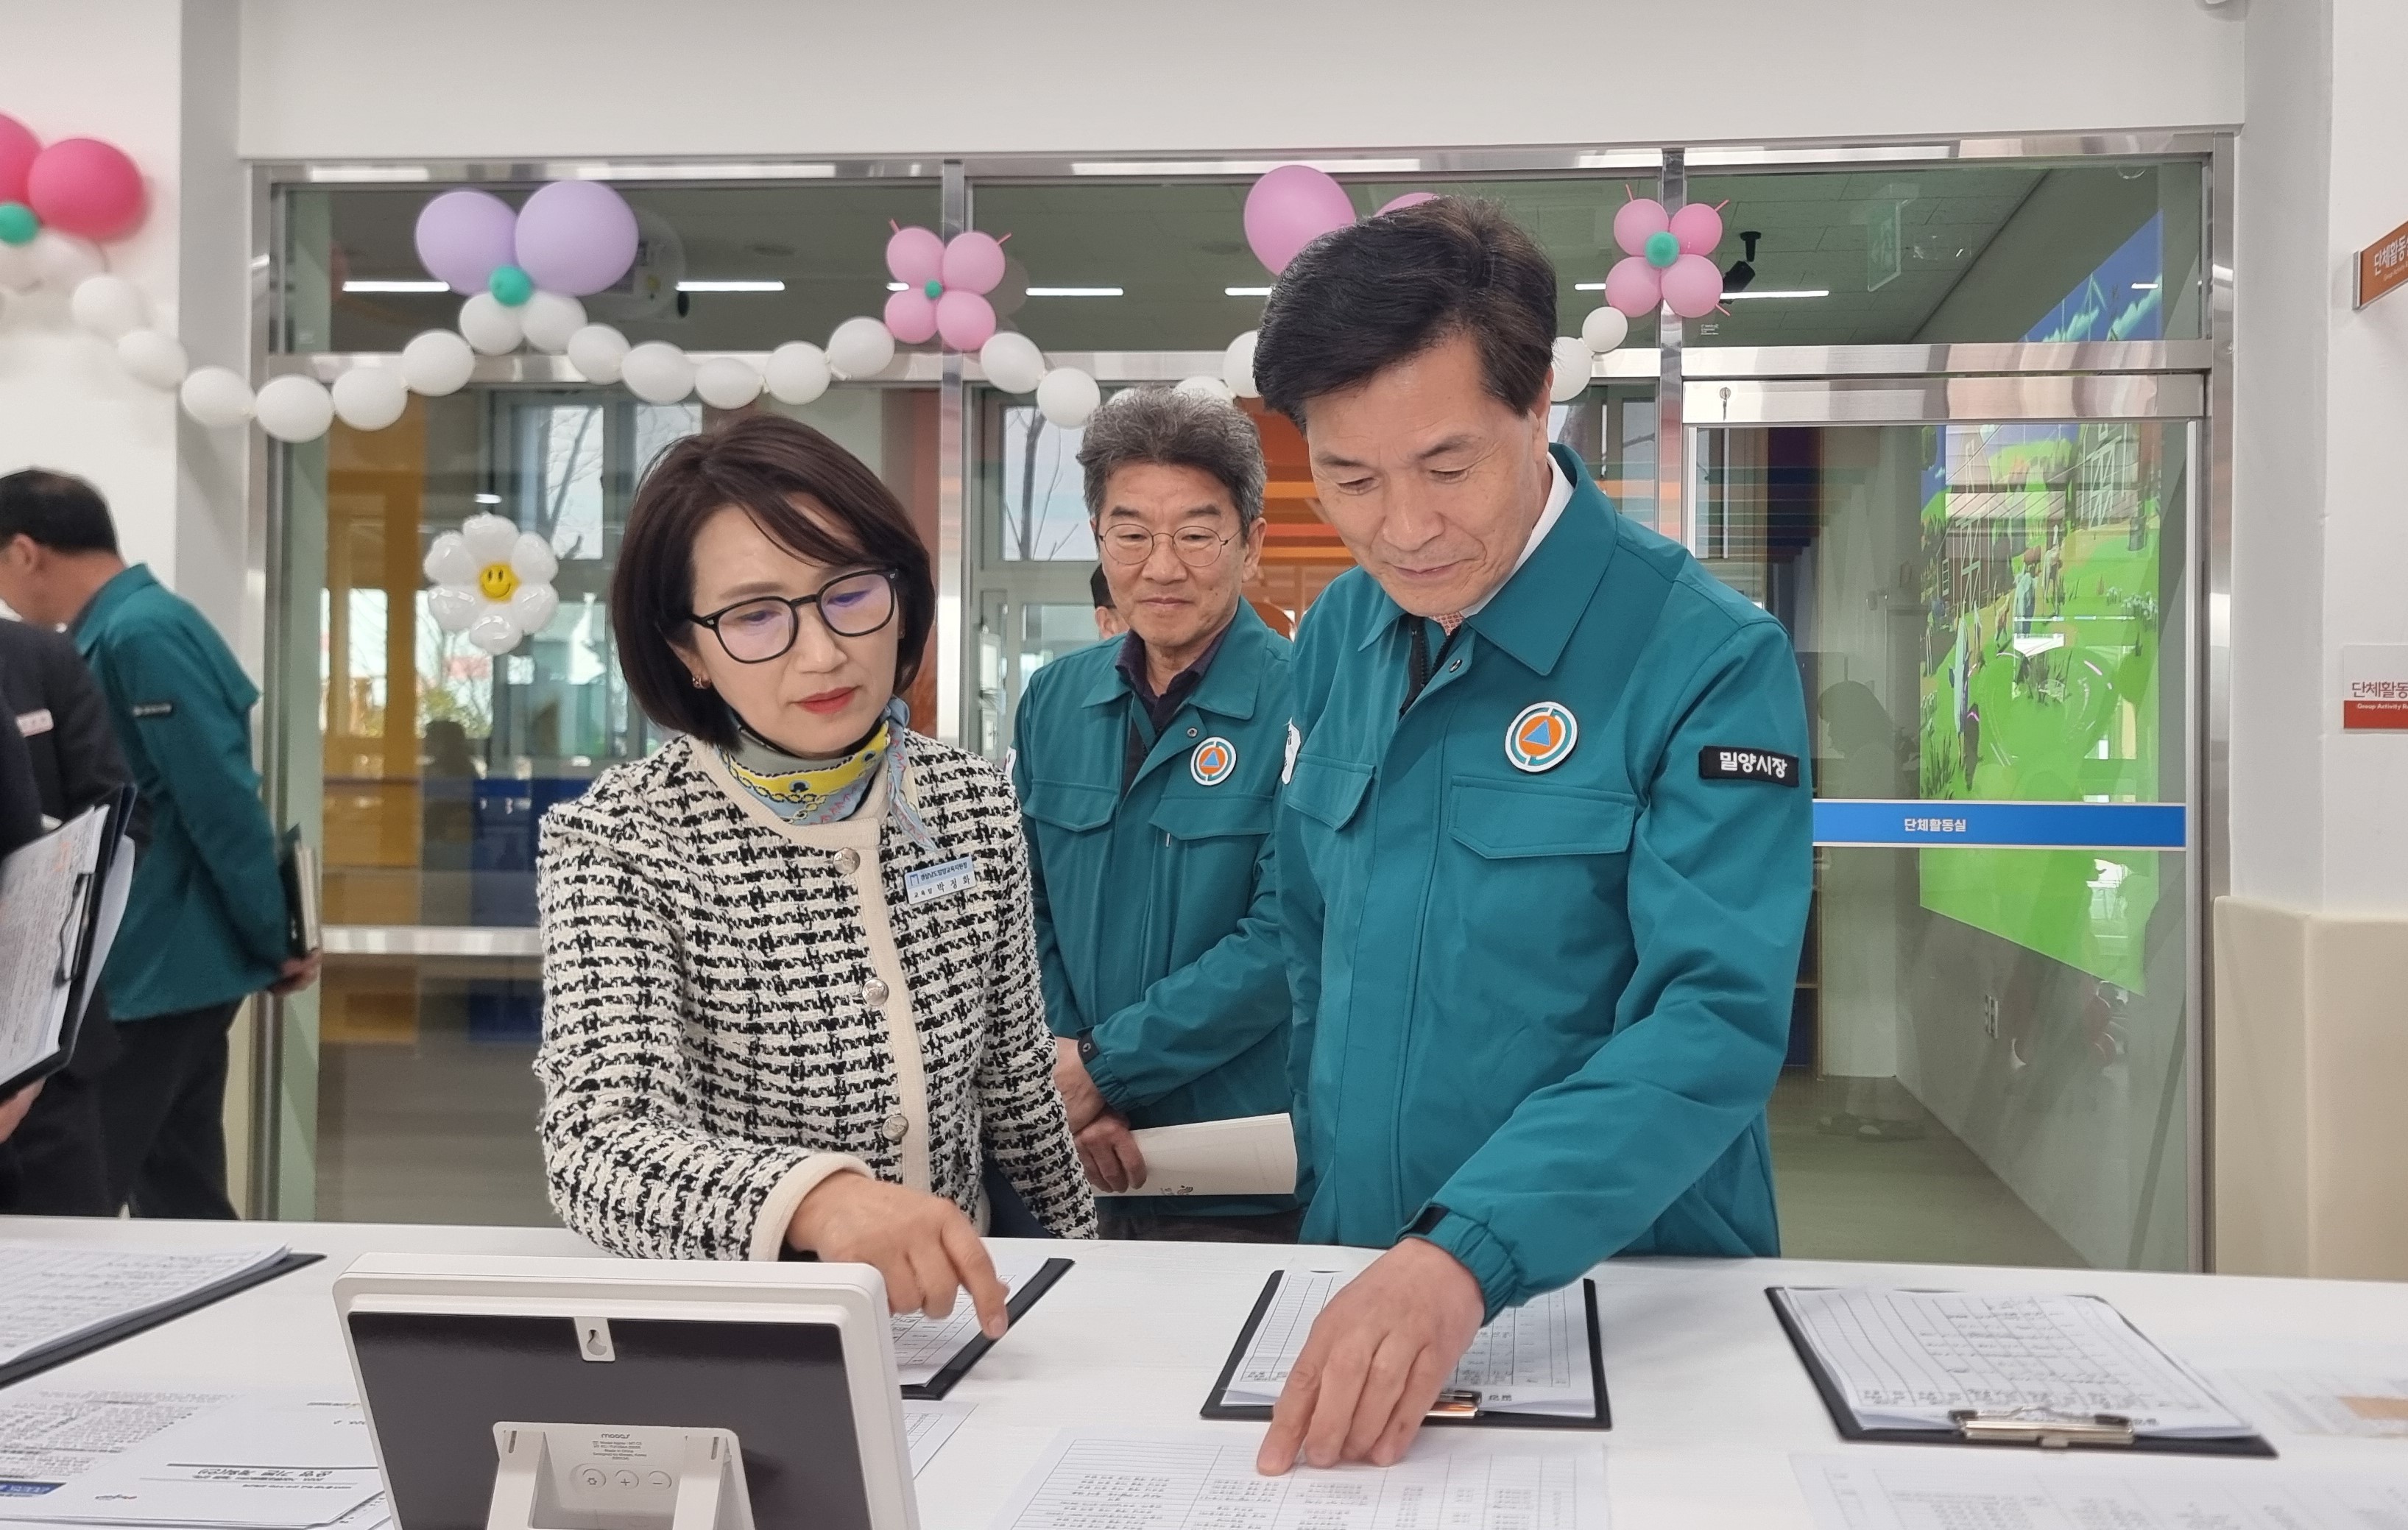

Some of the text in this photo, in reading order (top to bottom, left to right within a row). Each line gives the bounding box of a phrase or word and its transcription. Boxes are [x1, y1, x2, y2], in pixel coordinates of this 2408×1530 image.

[2374, 235, 2408, 277] 단체활동
[1720, 752, 1788, 778] 밀양시장
[1904, 818, 1966, 832] 단체활동실
